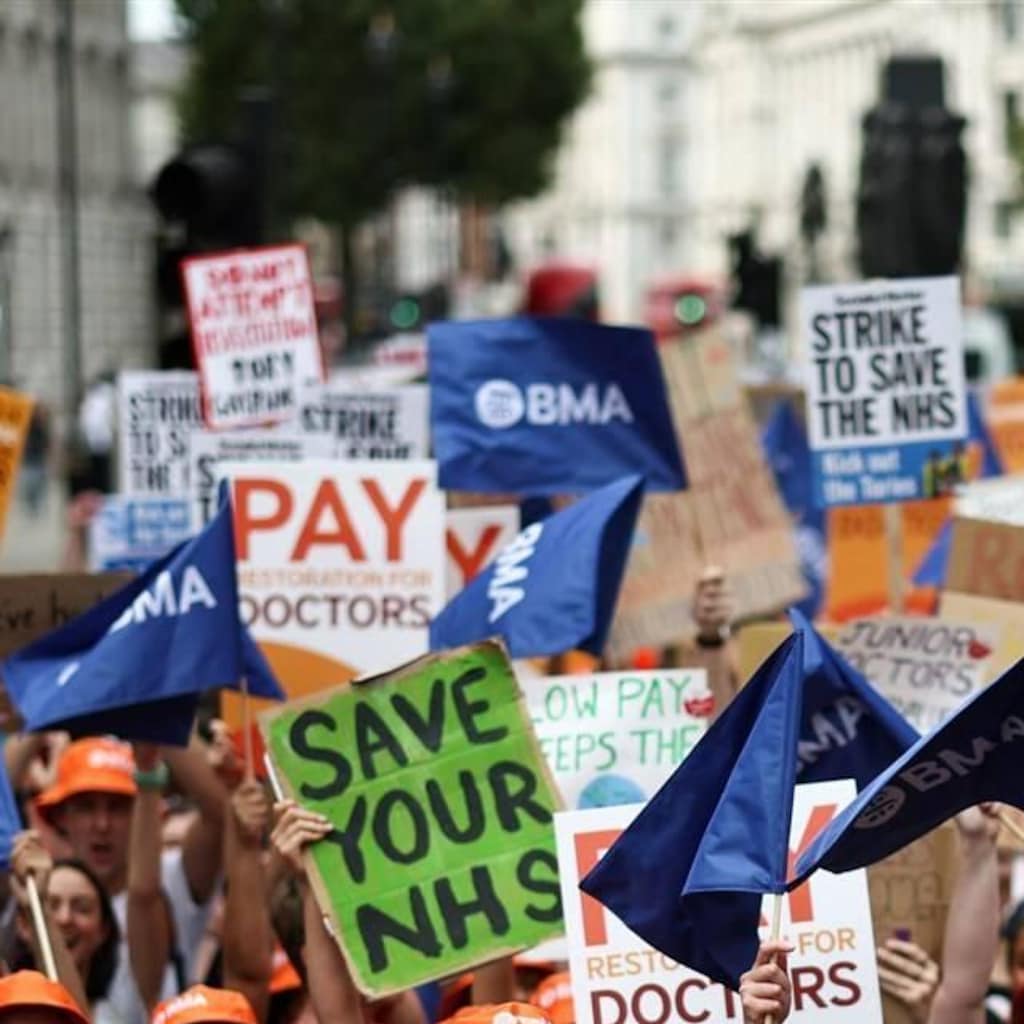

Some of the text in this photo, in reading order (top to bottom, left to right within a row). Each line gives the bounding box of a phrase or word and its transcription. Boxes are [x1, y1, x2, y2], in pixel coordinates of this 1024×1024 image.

[813, 306, 925, 350] STRIKE
[815, 348, 944, 394] TO SAVE
[526, 383, 635, 426] BMA
[818, 392, 955, 438] THE NHS
[233, 478, 425, 562] PAY
[110, 565, 217, 633] MA
[855, 652, 973, 695] CTORS
[618, 677, 690, 718] PAY
[289, 666, 506, 801] SAVE
[540, 731, 618, 772] EPS
[796, 694, 863, 770] MA
[326, 761, 552, 885] YOUR
[356, 847, 562, 975] NHS
[798, 928, 858, 955] FOR
